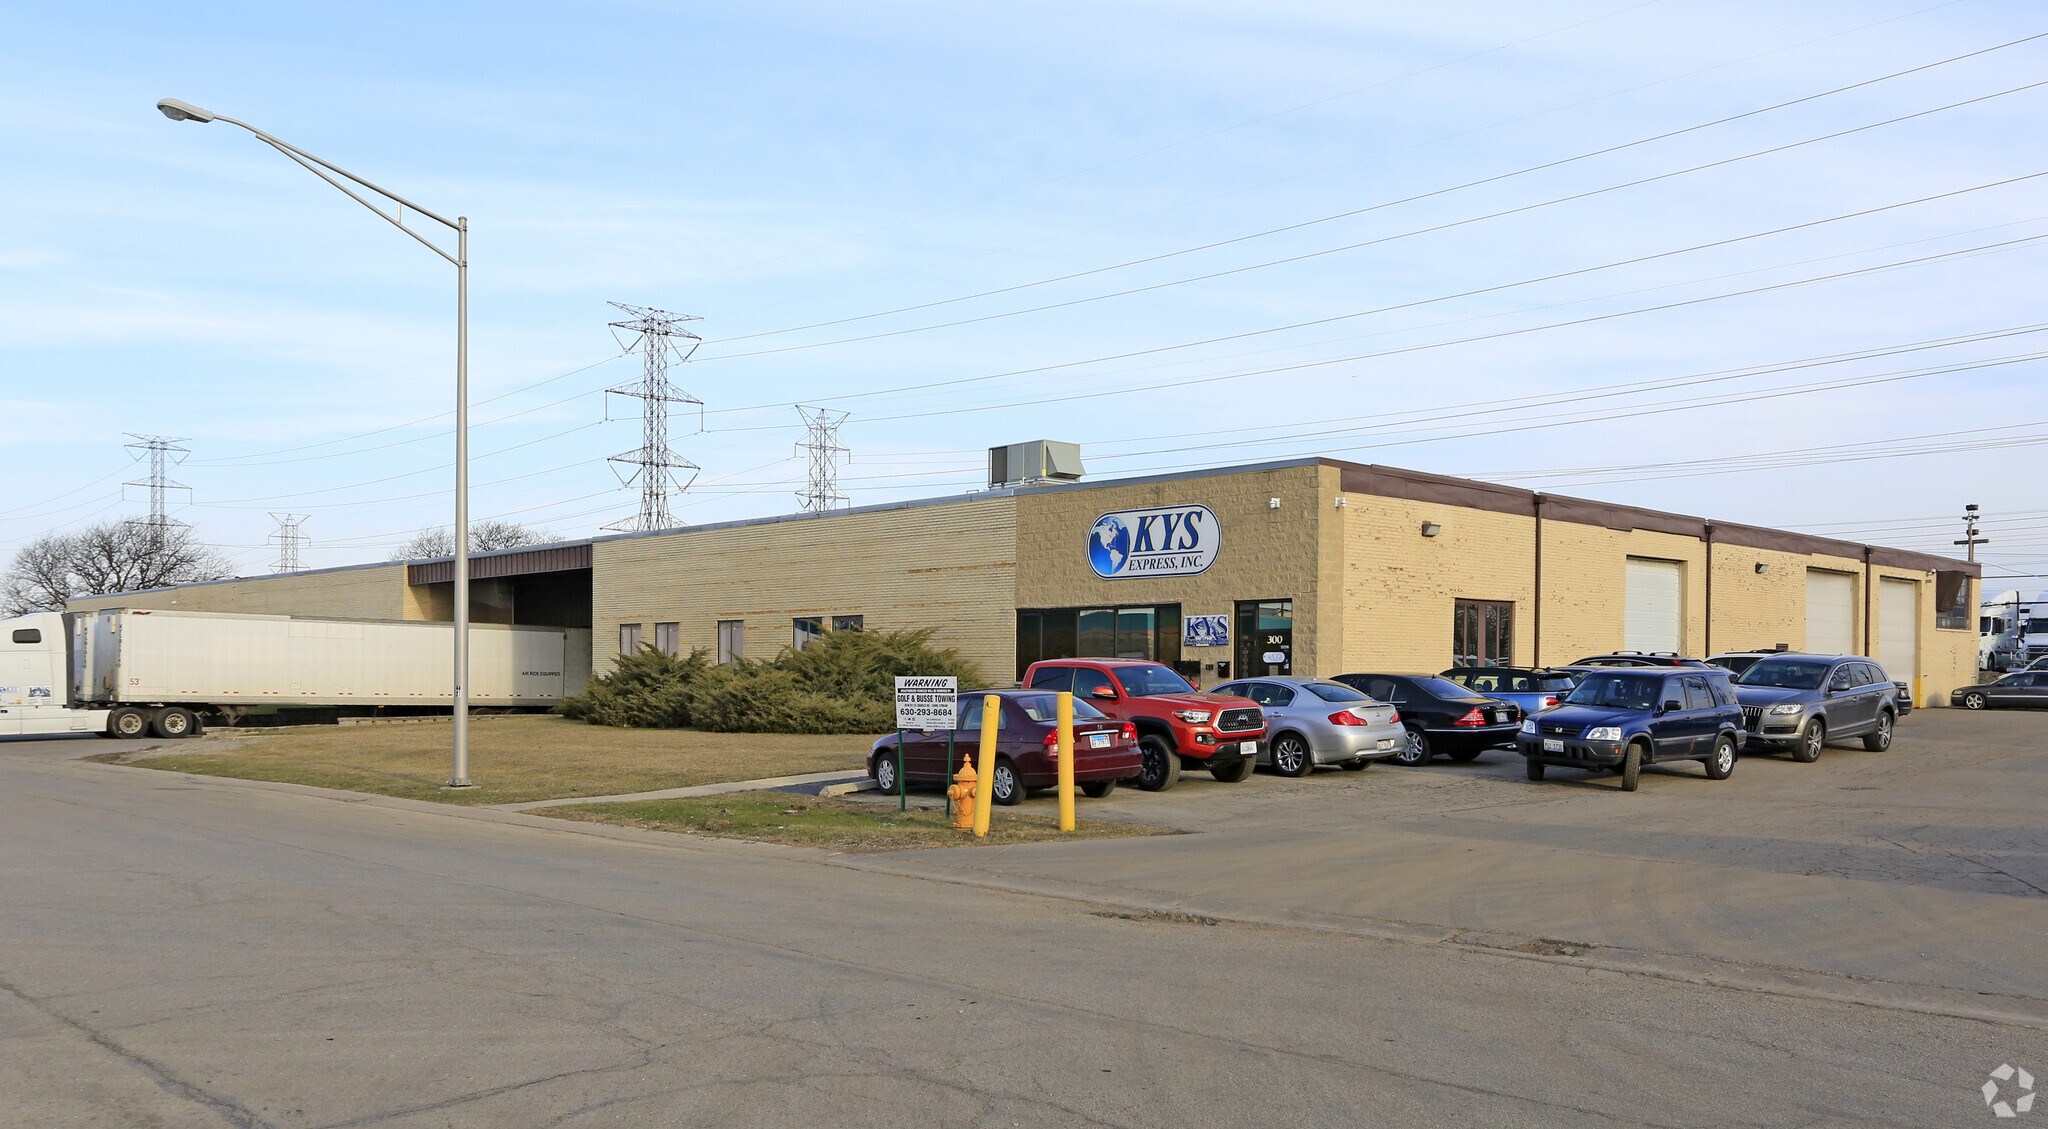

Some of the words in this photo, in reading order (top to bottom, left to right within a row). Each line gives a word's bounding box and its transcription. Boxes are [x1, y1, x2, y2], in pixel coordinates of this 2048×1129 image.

[1131, 510, 1203, 552] KYS
[1128, 557, 1178, 571] EXPRESS,
[1180, 555, 1203, 568] INC.
[1184, 616, 1228, 636] KYS
[1266, 635, 1283, 644] 300
[904, 679, 948, 687] WARNING
